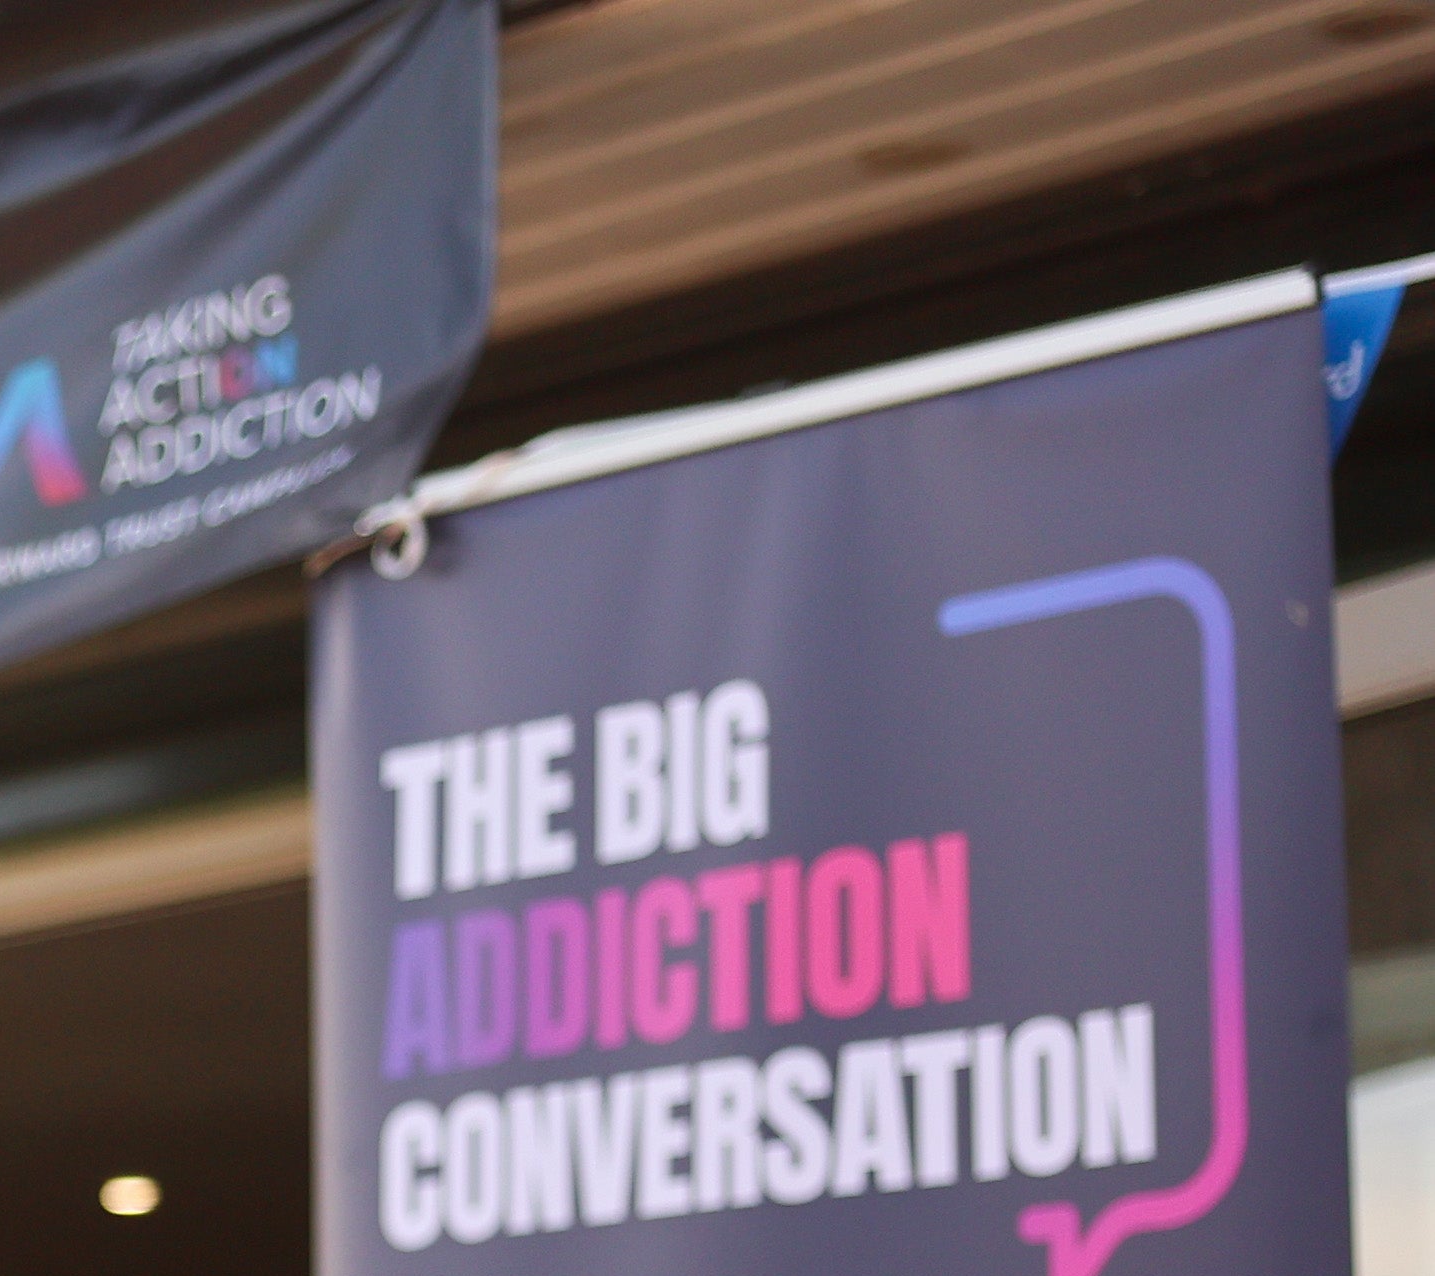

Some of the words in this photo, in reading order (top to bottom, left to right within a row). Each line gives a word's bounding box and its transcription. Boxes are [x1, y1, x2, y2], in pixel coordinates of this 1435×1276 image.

[98, 334, 298, 437] ACTION
[111, 273, 293, 374] TAKING
[100, 363, 383, 496] ADDICTION
[381, 714, 575, 900] THE
[595, 679, 769, 865] BIG
[381, 832, 970, 1080] ADDICTION
[380, 1004, 1156, 1252] CONVERSATION
